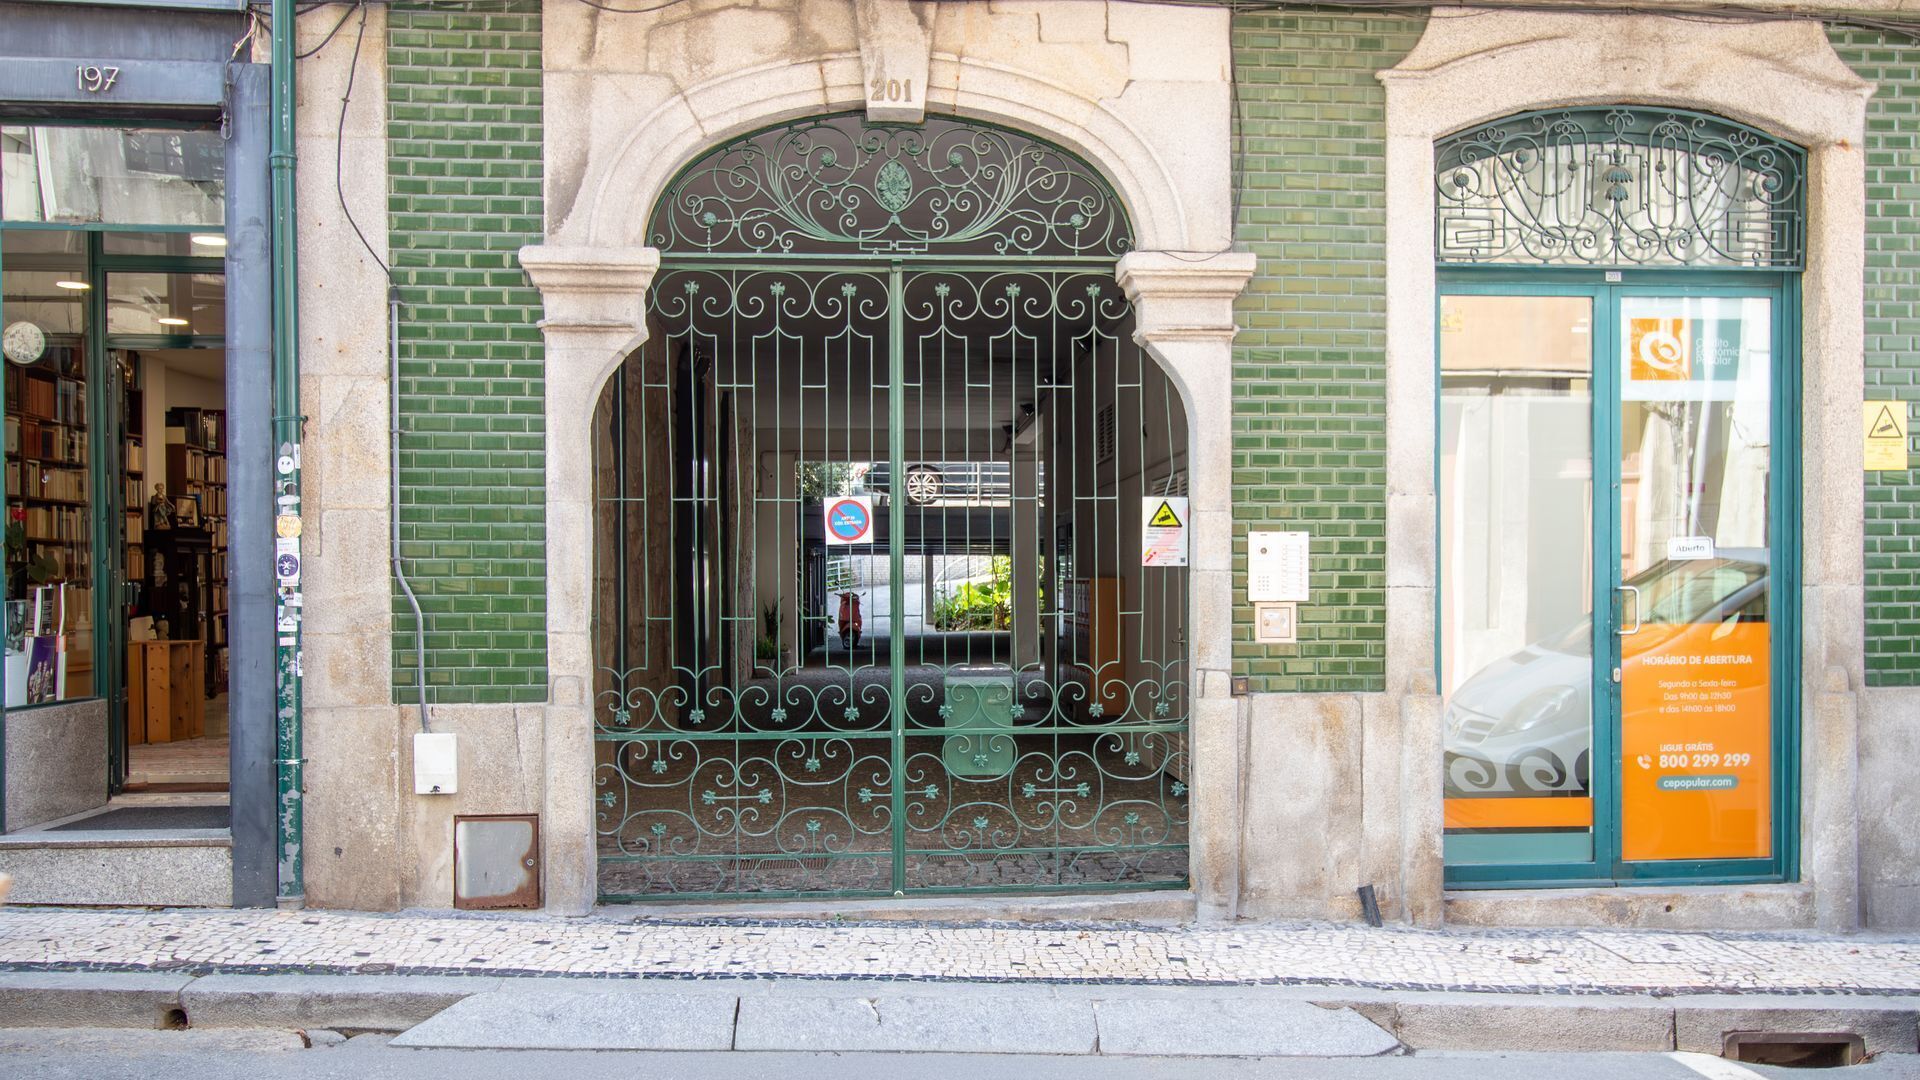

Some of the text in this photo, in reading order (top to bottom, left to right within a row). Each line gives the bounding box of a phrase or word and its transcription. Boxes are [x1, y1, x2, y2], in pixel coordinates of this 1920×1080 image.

[76, 65, 119, 91] 197
[871, 79, 912, 102] 201
[1676, 544, 1705, 552] Aberto
[1642, 654, 1752, 665] HORÁRIO DE ABERTURA
[1658, 680, 1691, 689] Segunda
[1664, 692, 1678, 700] Das
[1681, 704, 1702, 712] 14h00
[1715, 704, 1736, 712] 18h00
[1660, 741, 1713, 752] LIGUE GRÁTIS
[1659, 753, 1750, 768] 800 299 299
[1663, 777, 1732, 789] cepopular.com
